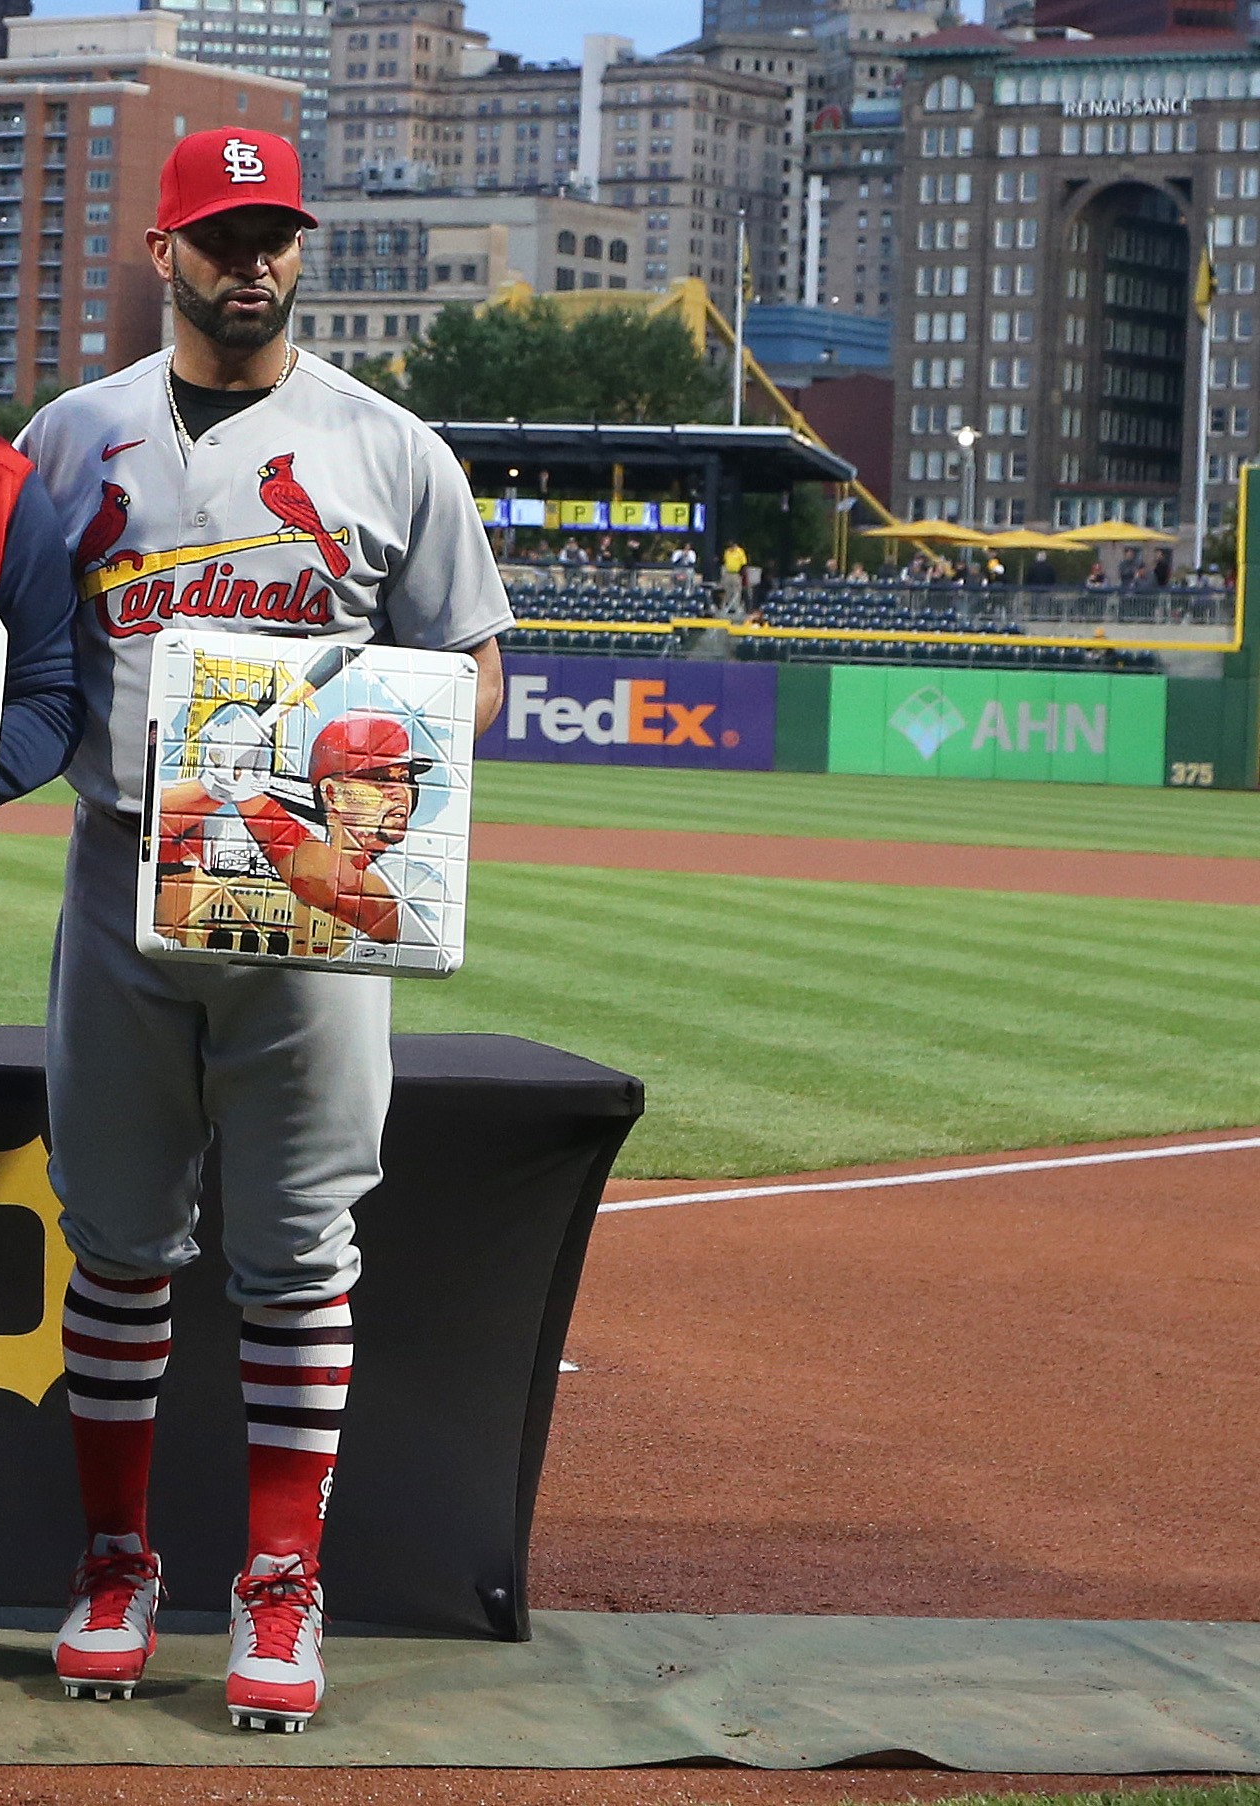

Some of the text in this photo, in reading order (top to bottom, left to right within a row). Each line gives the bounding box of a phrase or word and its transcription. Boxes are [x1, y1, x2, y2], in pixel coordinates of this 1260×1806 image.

[1062, 98, 1191, 117] RENAISSANCE
[94, 550, 334, 638] Cardinals
[507, 674, 717, 747] FedEx
[971, 701, 1108, 754] AHN
[1171, 762, 1214, 785] 375
